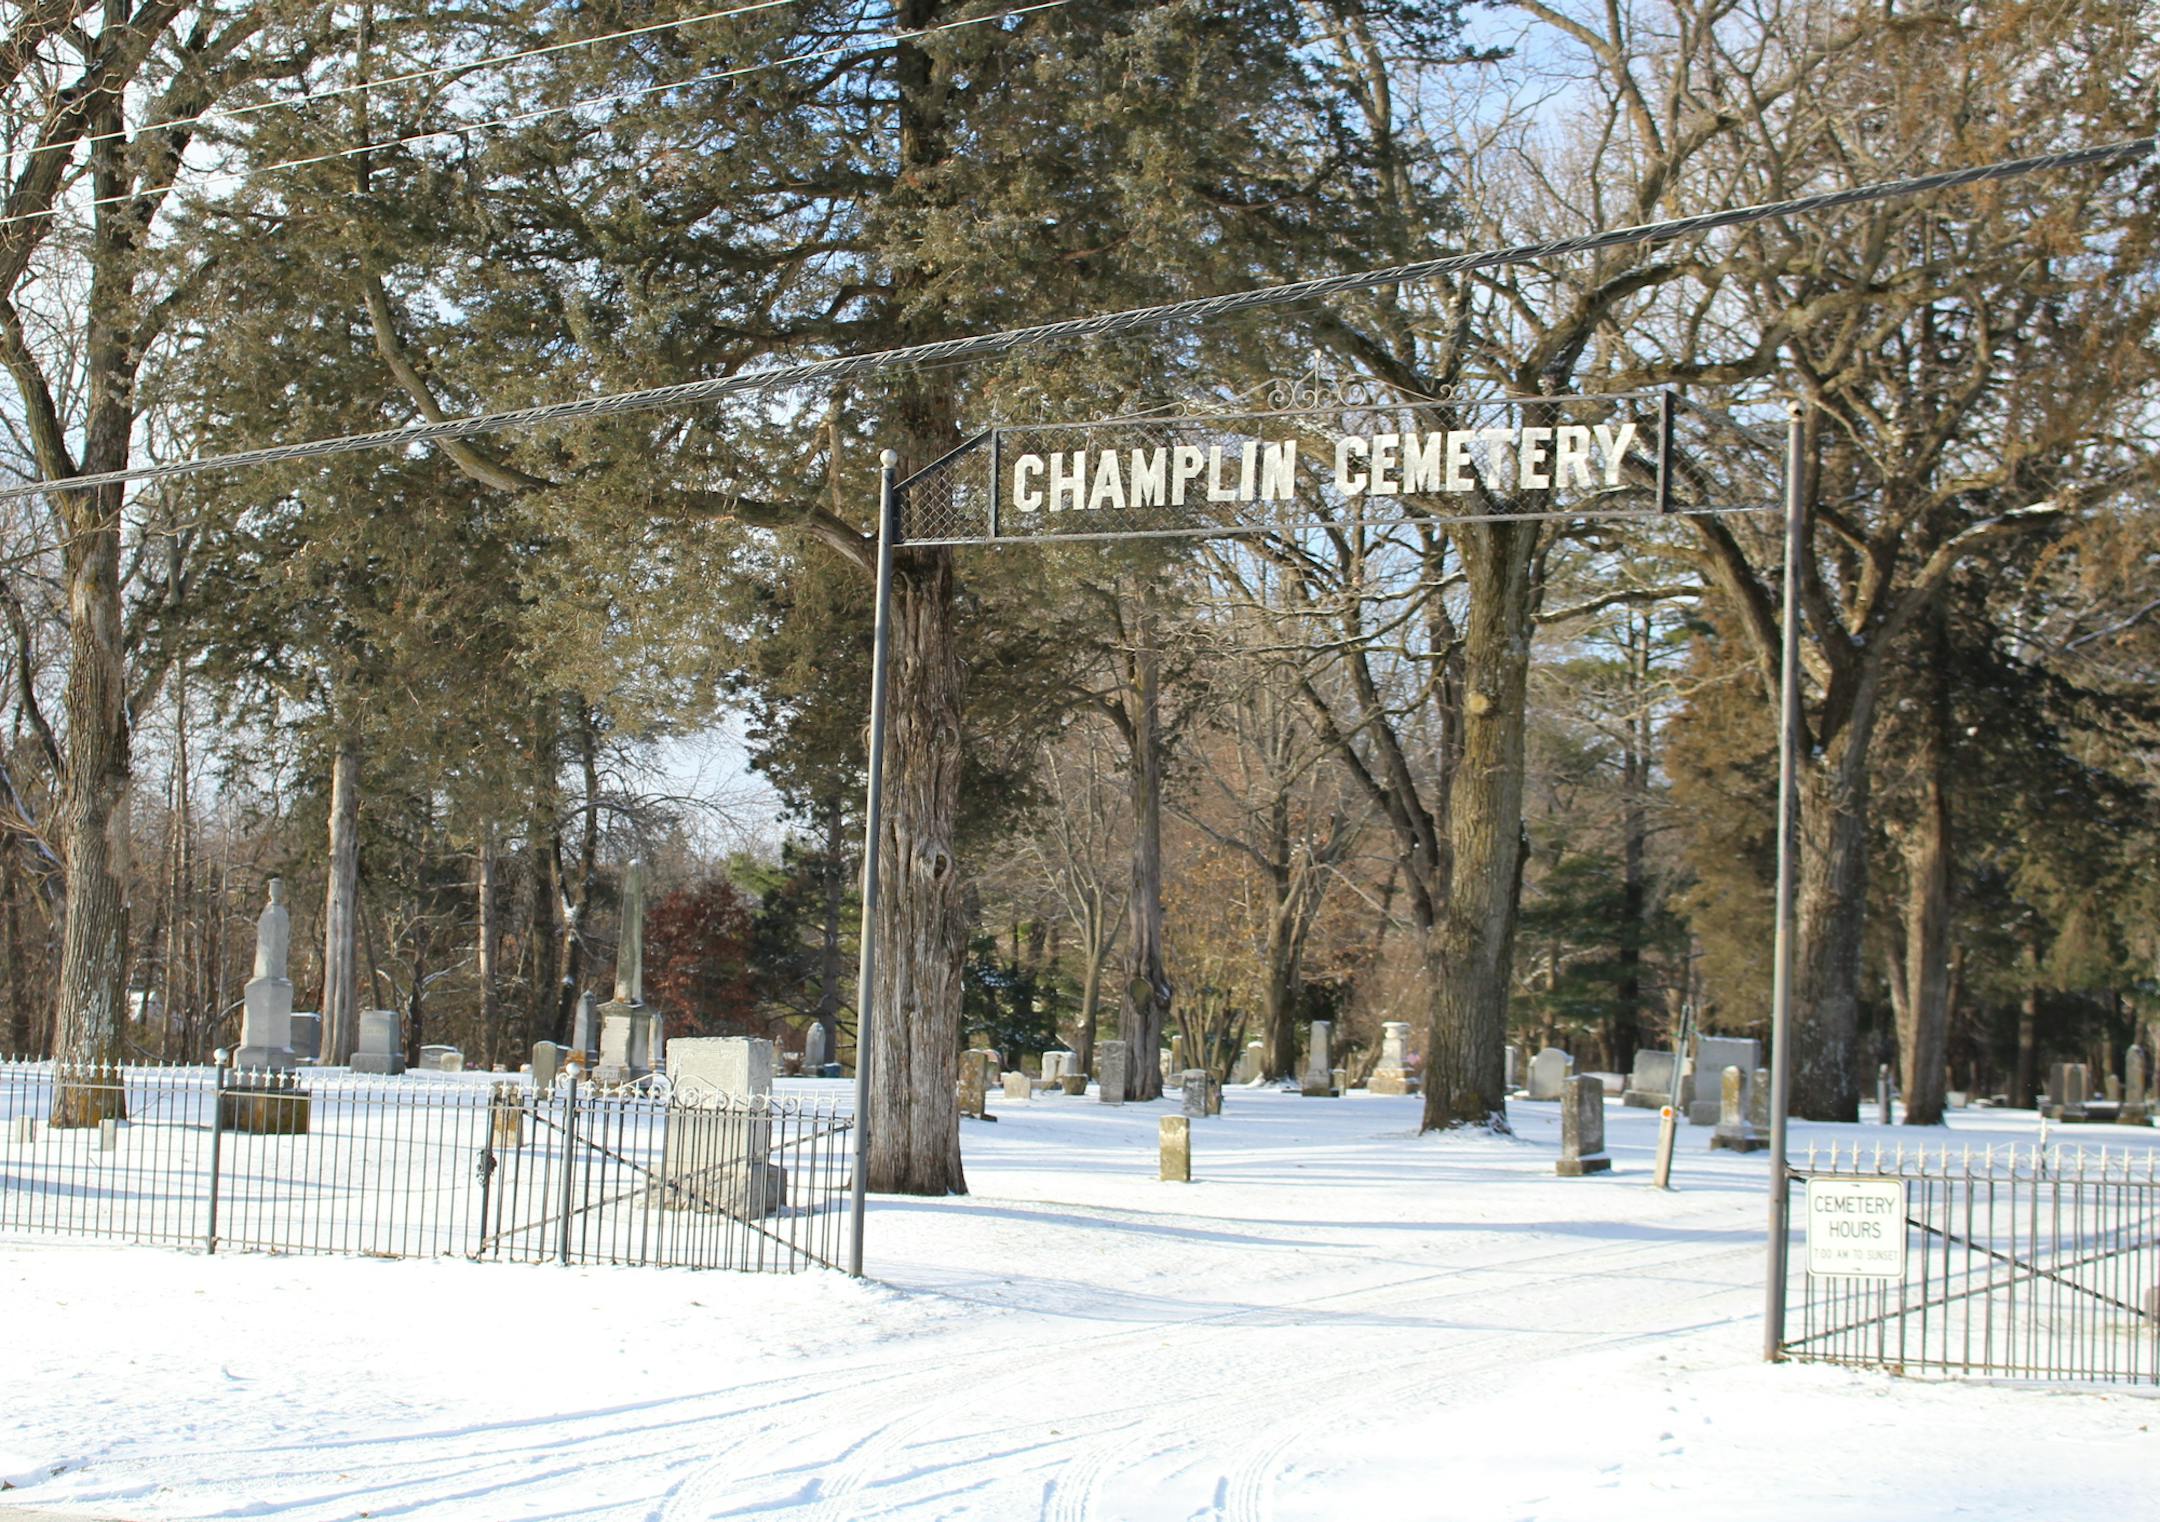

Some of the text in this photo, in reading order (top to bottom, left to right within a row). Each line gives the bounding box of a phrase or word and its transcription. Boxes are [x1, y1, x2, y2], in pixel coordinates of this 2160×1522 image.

[1013, 422, 1637, 512] CHAMPLIN CEMETERY
[1814, 1195, 1896, 1214] CEMETERY
[1829, 1220, 1881, 1239] HOURS
[1837, 1248, 1849, 1259] AM
[1853, 1248, 1864, 1260] TO
[1867, 1249, 1899, 1261] SUNSET
